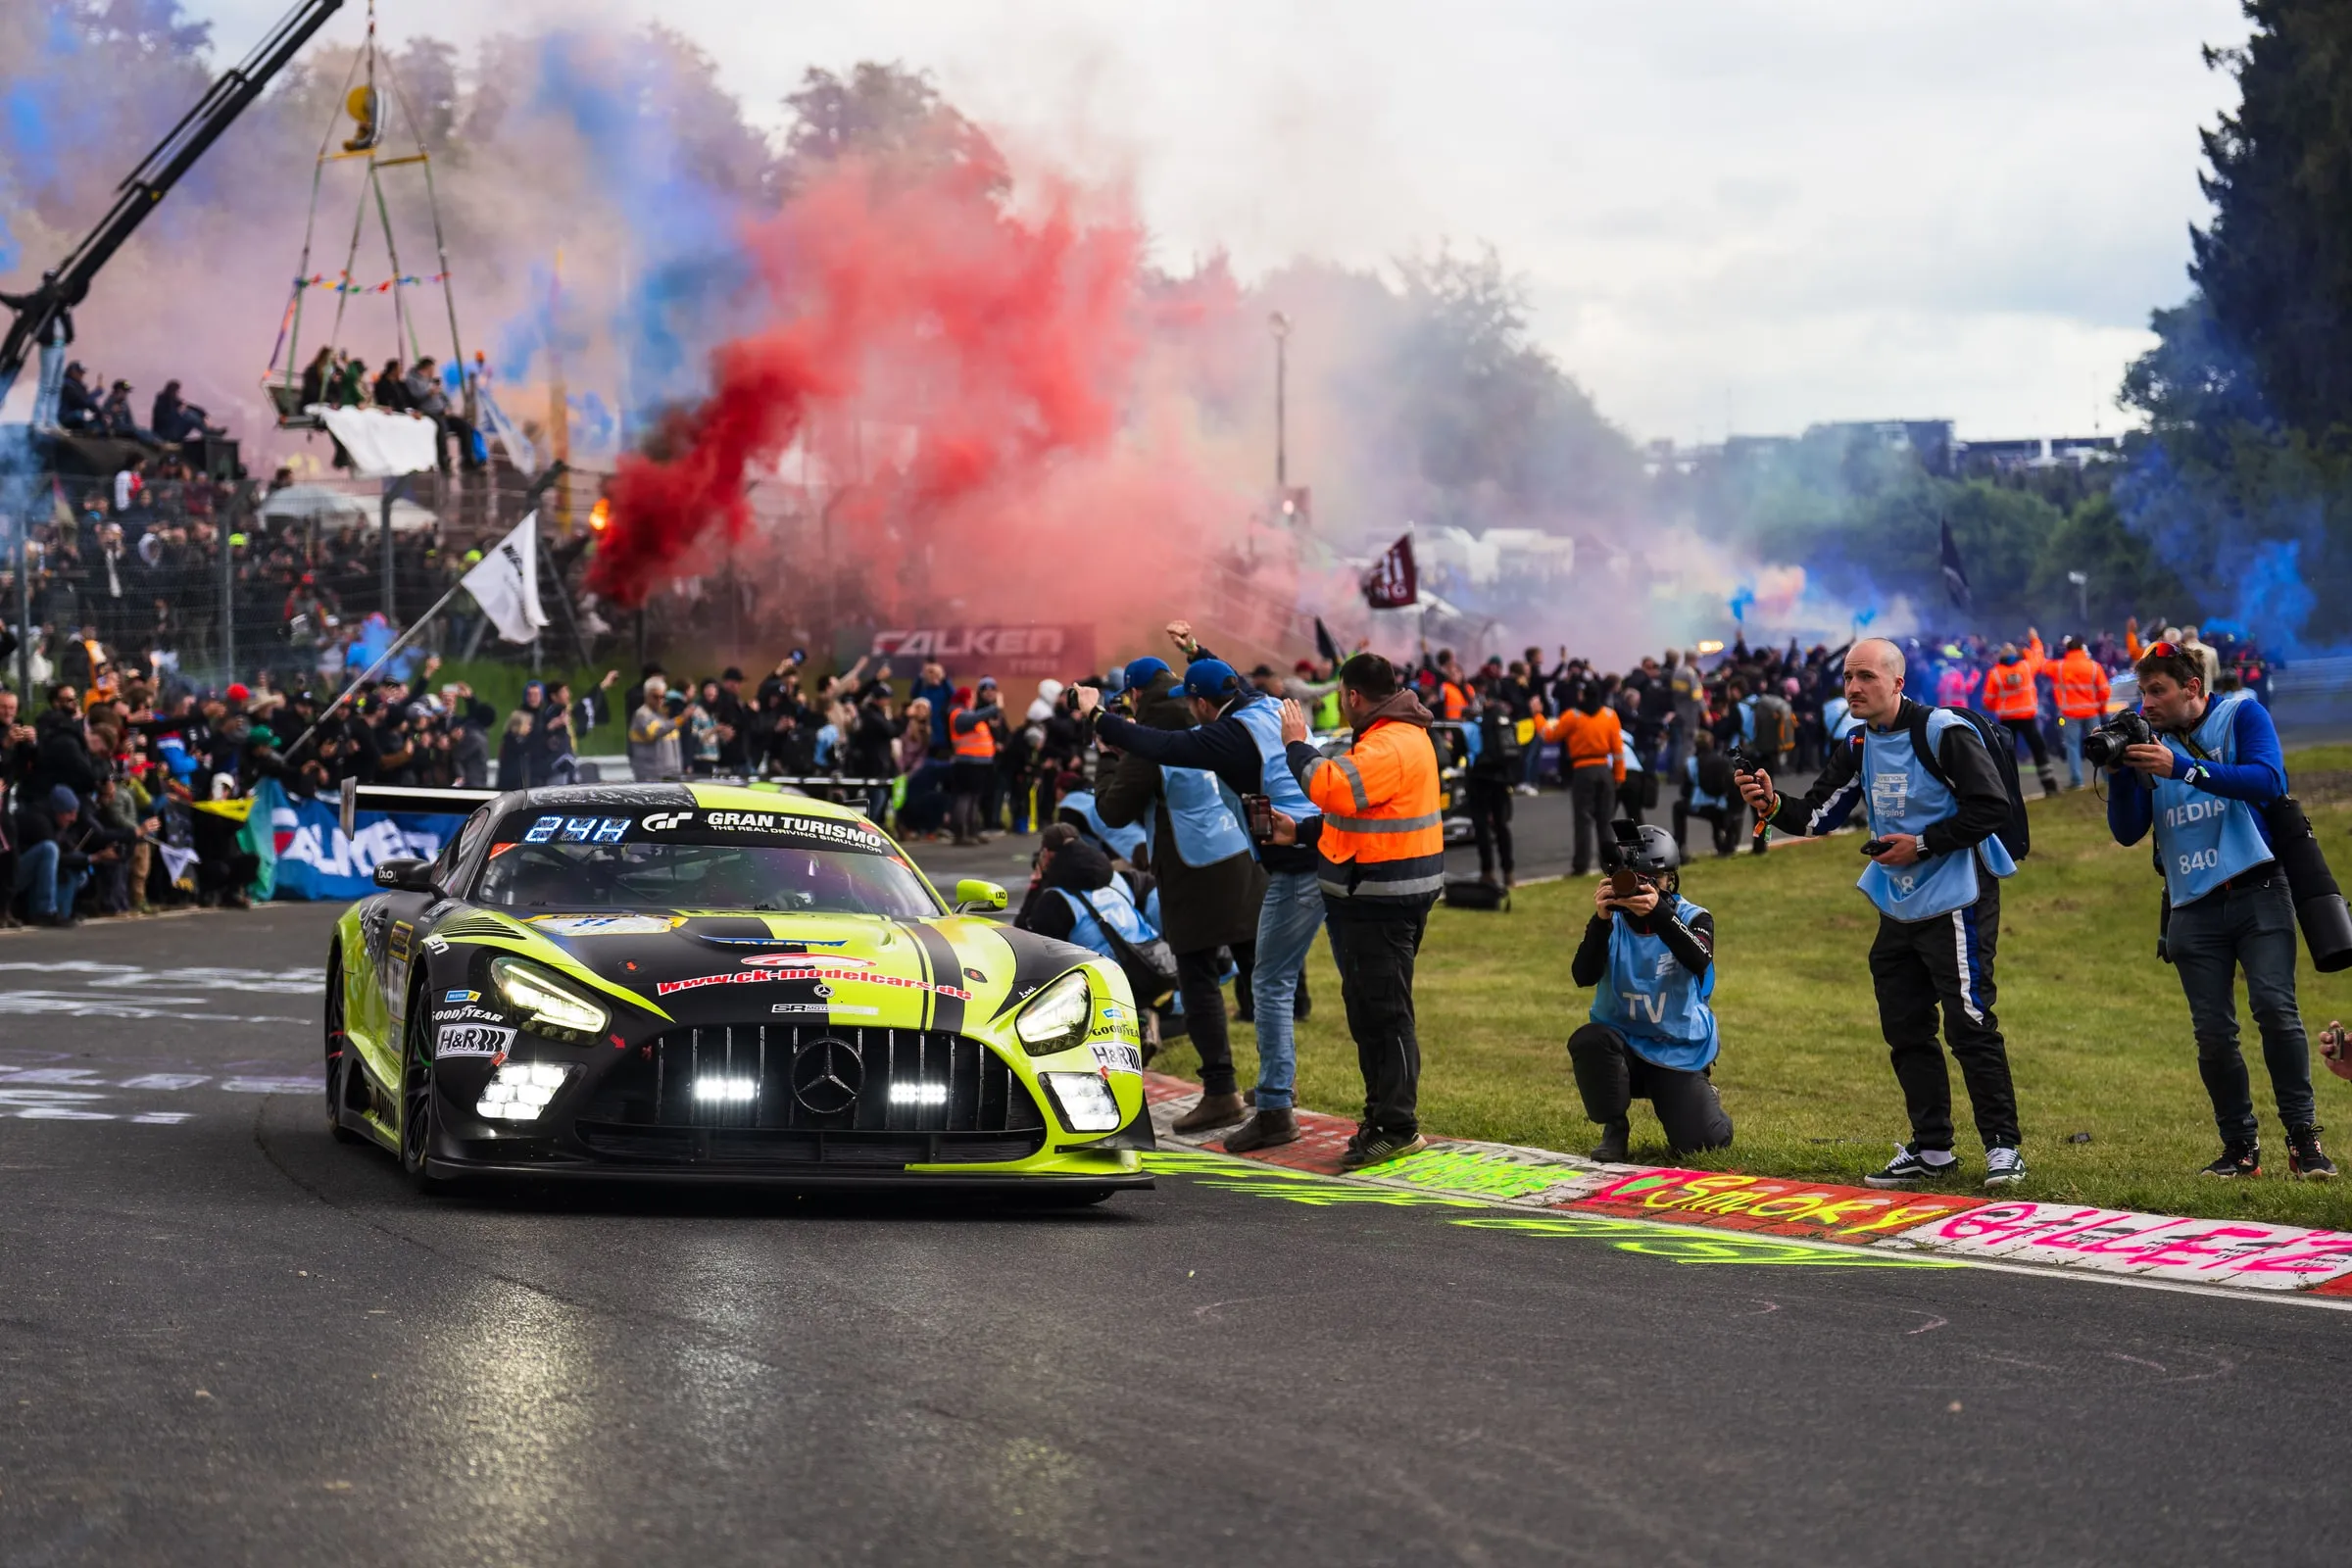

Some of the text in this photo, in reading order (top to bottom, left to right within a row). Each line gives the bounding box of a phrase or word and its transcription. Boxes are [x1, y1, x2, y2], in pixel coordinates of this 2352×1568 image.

[870, 629, 1065, 657] FALKEN
[2163, 799, 2226, 828] MEDIA
[524, 815, 632, 842] 24H
[708, 811, 881, 848] GRAN TURISMO
[770, 828, 817, 839] DRIVING
[819, 835, 883, 854] SIMULATOR
[2179, 849, 2218, 875] 840
[658, 968, 973, 1002] www.ck-modelcars.de
[1622, 992, 1667, 1024] TV
[438, 1028, 478, 1054] H&R
